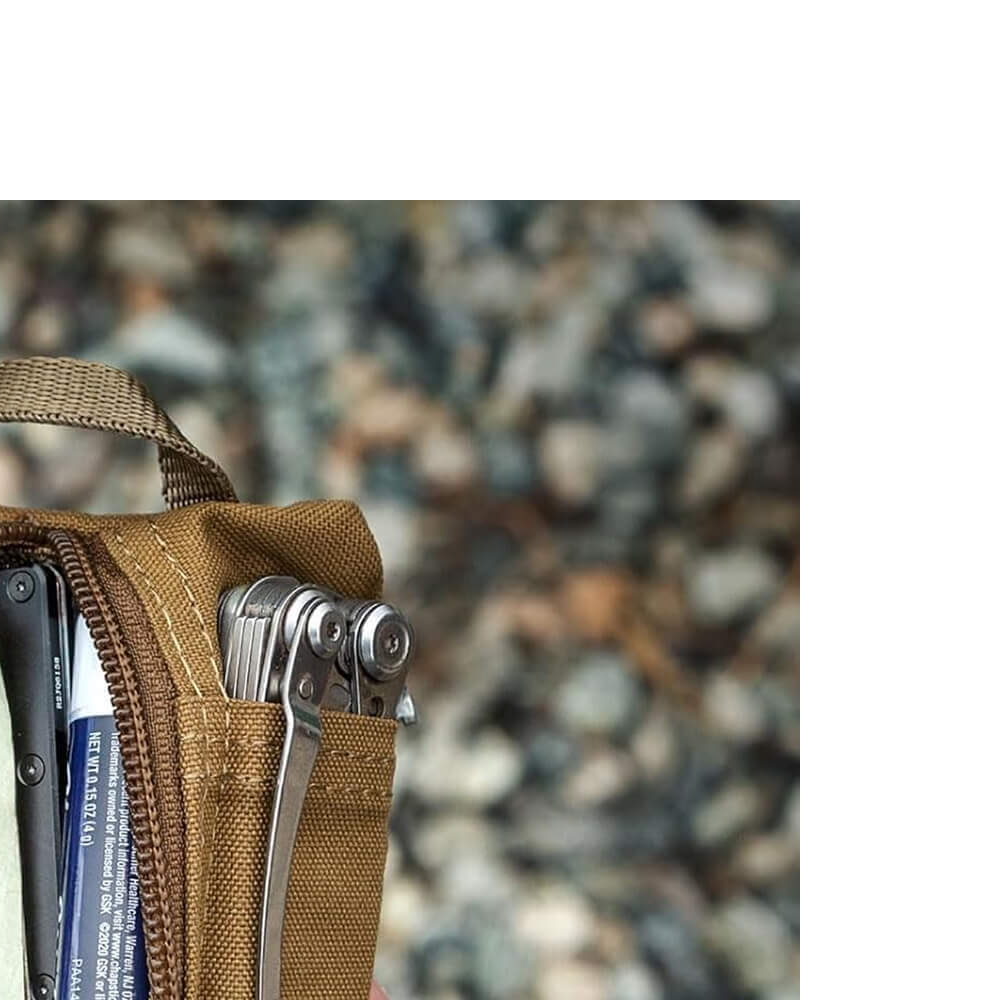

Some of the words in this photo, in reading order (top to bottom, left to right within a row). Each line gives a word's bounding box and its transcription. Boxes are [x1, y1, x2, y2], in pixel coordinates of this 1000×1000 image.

[87, 732, 102, 753] NET
[86, 755, 100, 774] WT
[108, 732, 121, 787] Trademarks
[85, 776, 99, 801] 0.15
[83, 803, 97, 818] OZ
[106, 790, 118, 822] owned
[105, 825, 115, 834] or
[118, 808, 130, 846] product
[103, 837, 116, 877] licensed
[100, 880, 113, 892] by
[113, 849, 128, 907] information,
[100, 894, 112, 914] GSK
[125, 878, 140, 934] Healthcare,
[114, 909, 125, 931] visit
[122, 935, 137, 973] Warren,
[95, 958, 108, 979] GSK
[94, 981, 104, 991] or
[122, 975, 133, 989] NJ
